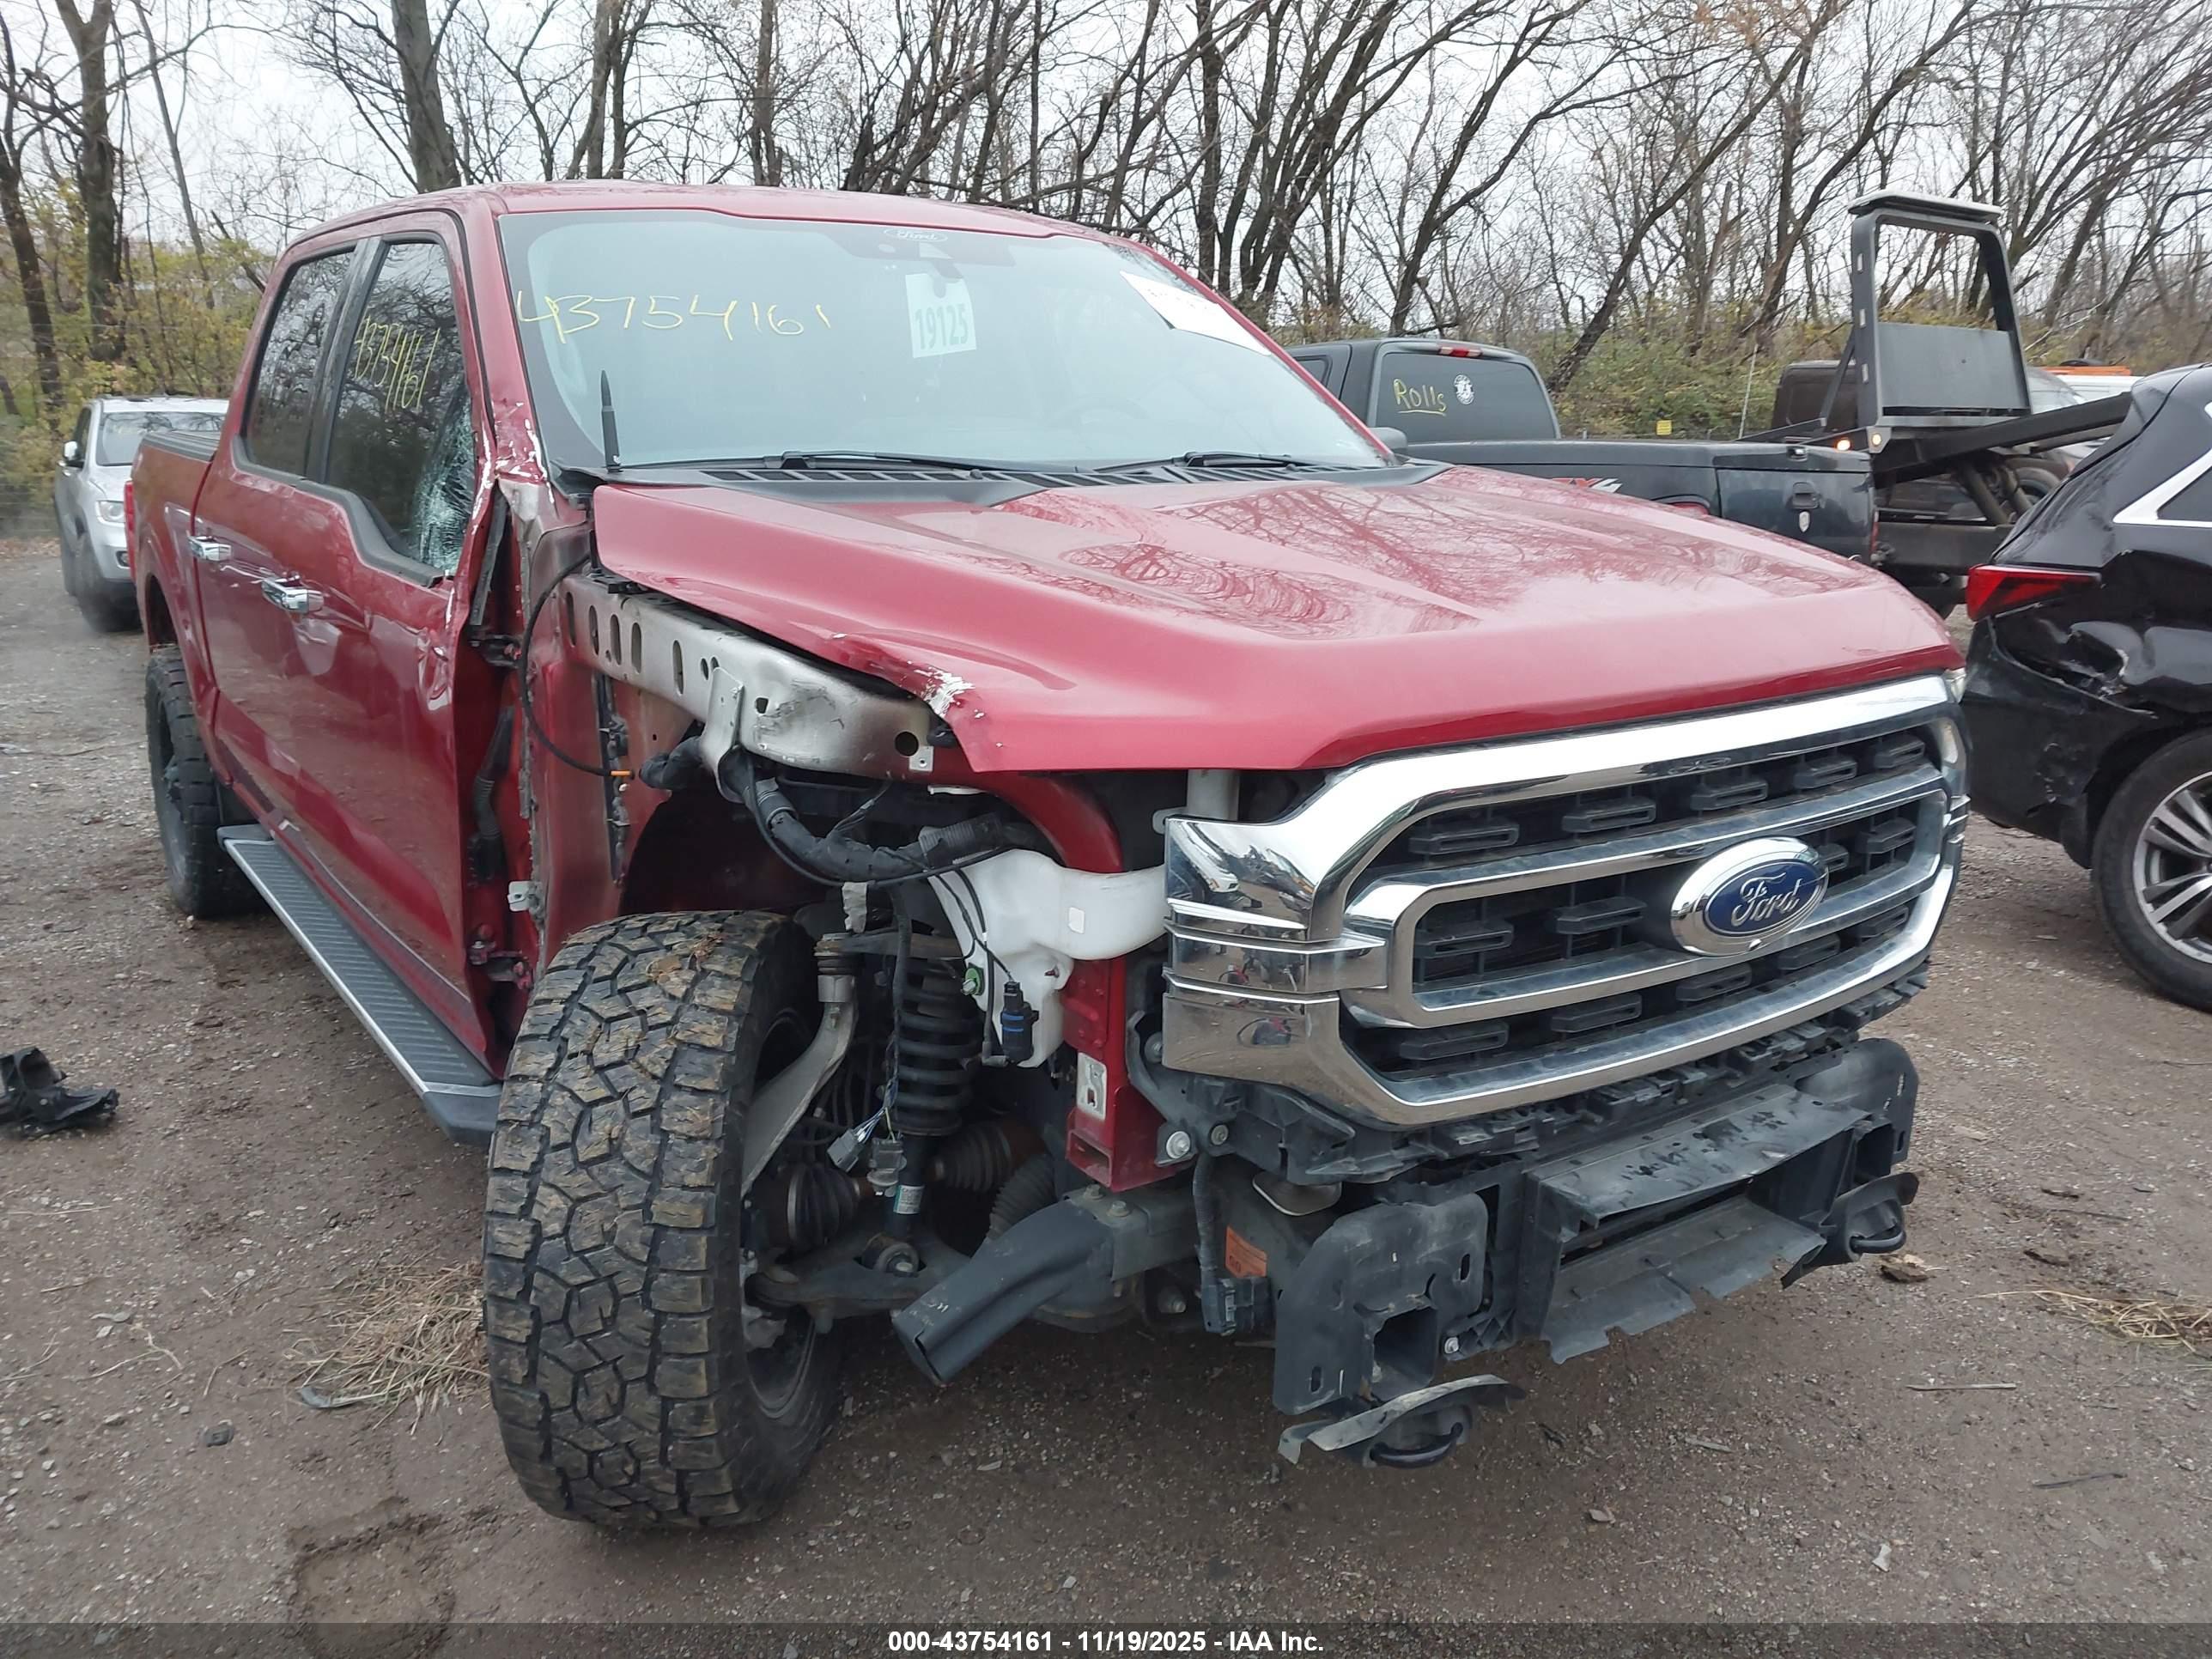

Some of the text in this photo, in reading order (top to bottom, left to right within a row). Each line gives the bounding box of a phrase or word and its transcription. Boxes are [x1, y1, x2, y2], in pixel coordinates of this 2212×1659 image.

[517, 290, 831, 344] 43754161
[915, 303, 969, 349] 19125
[1731, 872, 1804, 927] Ford
